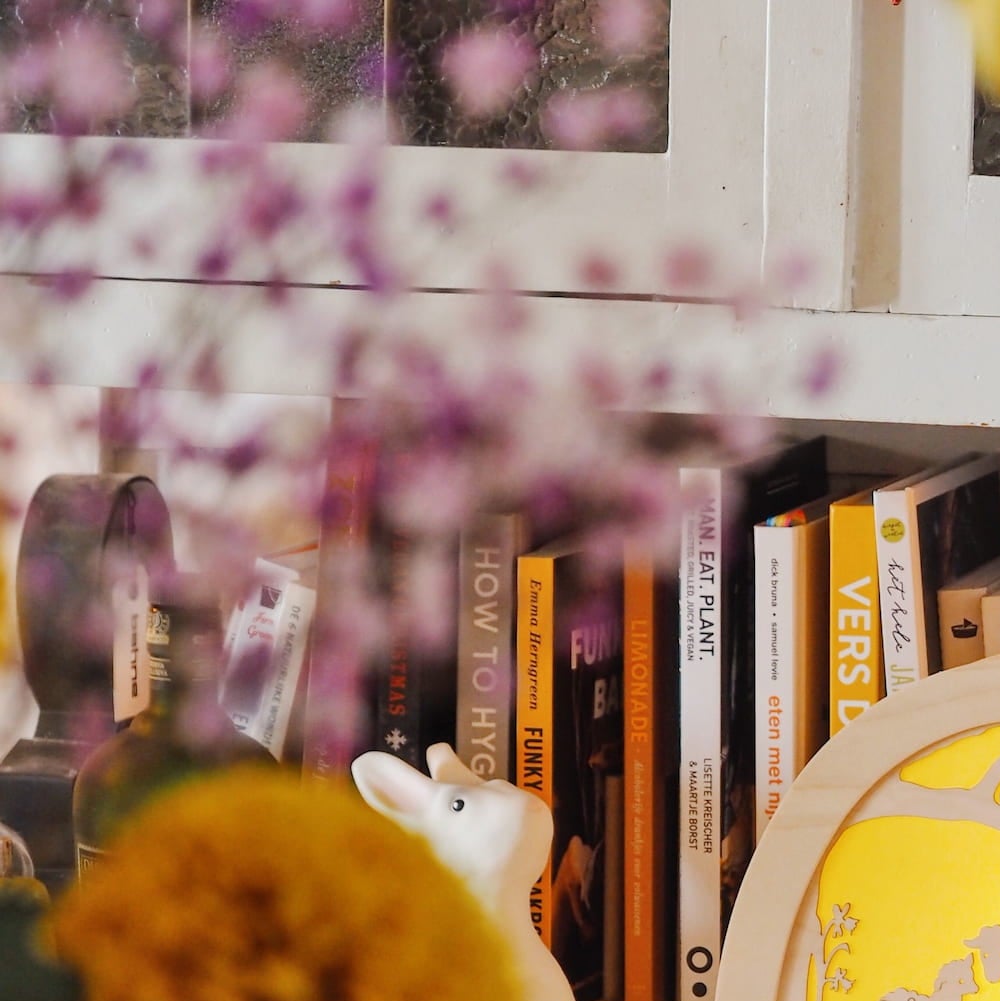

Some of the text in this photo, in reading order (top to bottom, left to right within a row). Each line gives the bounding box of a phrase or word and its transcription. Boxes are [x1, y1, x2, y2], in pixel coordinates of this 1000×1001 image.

[474, 548, 500, 633] HOW
[698, 551, 715, 589] EAT.
[771, 557, 779, 578] dick
[887, 558, 906, 600] het
[528, 578, 542, 710] Emma Herngreen
[686, 632, 694, 661] VEGAN
[698, 594, 715, 661] PLANT.
[838, 576, 871, 685] VERS
[472, 646, 498, 692] TO
[631, 620, 648, 743] LIMONADE
[771, 654, 779, 681] levie
[890, 664, 916, 692] JA
[524, 727, 543, 792] FUNKY
[764, 695, 783, 820] eten met nij
[688, 760, 698, 851] & MAARTJE BORST
[703, 758, 713, 854] LISETTE KREISCHER
